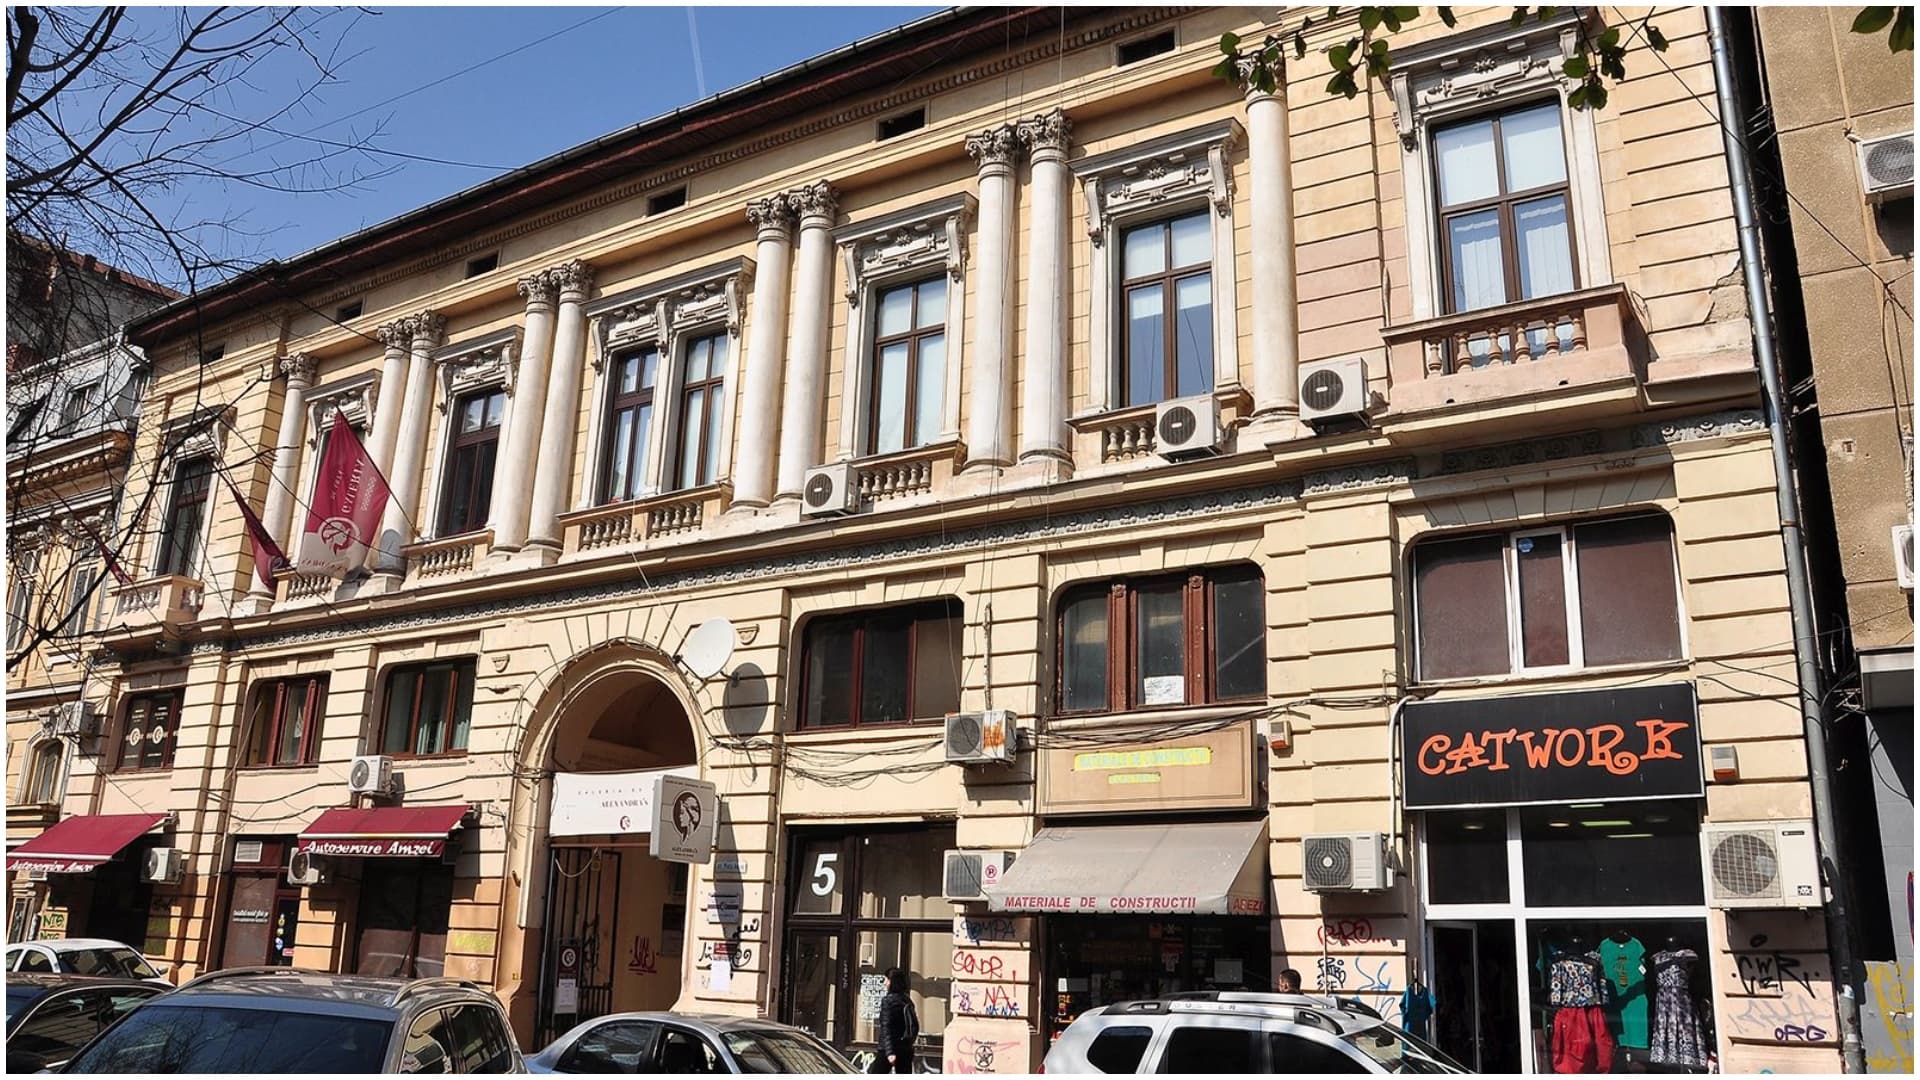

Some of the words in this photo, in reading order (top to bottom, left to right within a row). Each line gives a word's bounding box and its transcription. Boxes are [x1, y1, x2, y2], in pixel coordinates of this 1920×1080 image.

[1417, 719, 1689, 776] CATWORK
[302, 840, 382, 854] Autoservire
[386, 841, 435, 855] Amzei
[811, 852, 838, 897] 5
[1004, 896, 1071, 908] MATERIALE
[1079, 896, 1097, 908] DE
[1109, 896, 1196, 909] CONSTRUCTII
